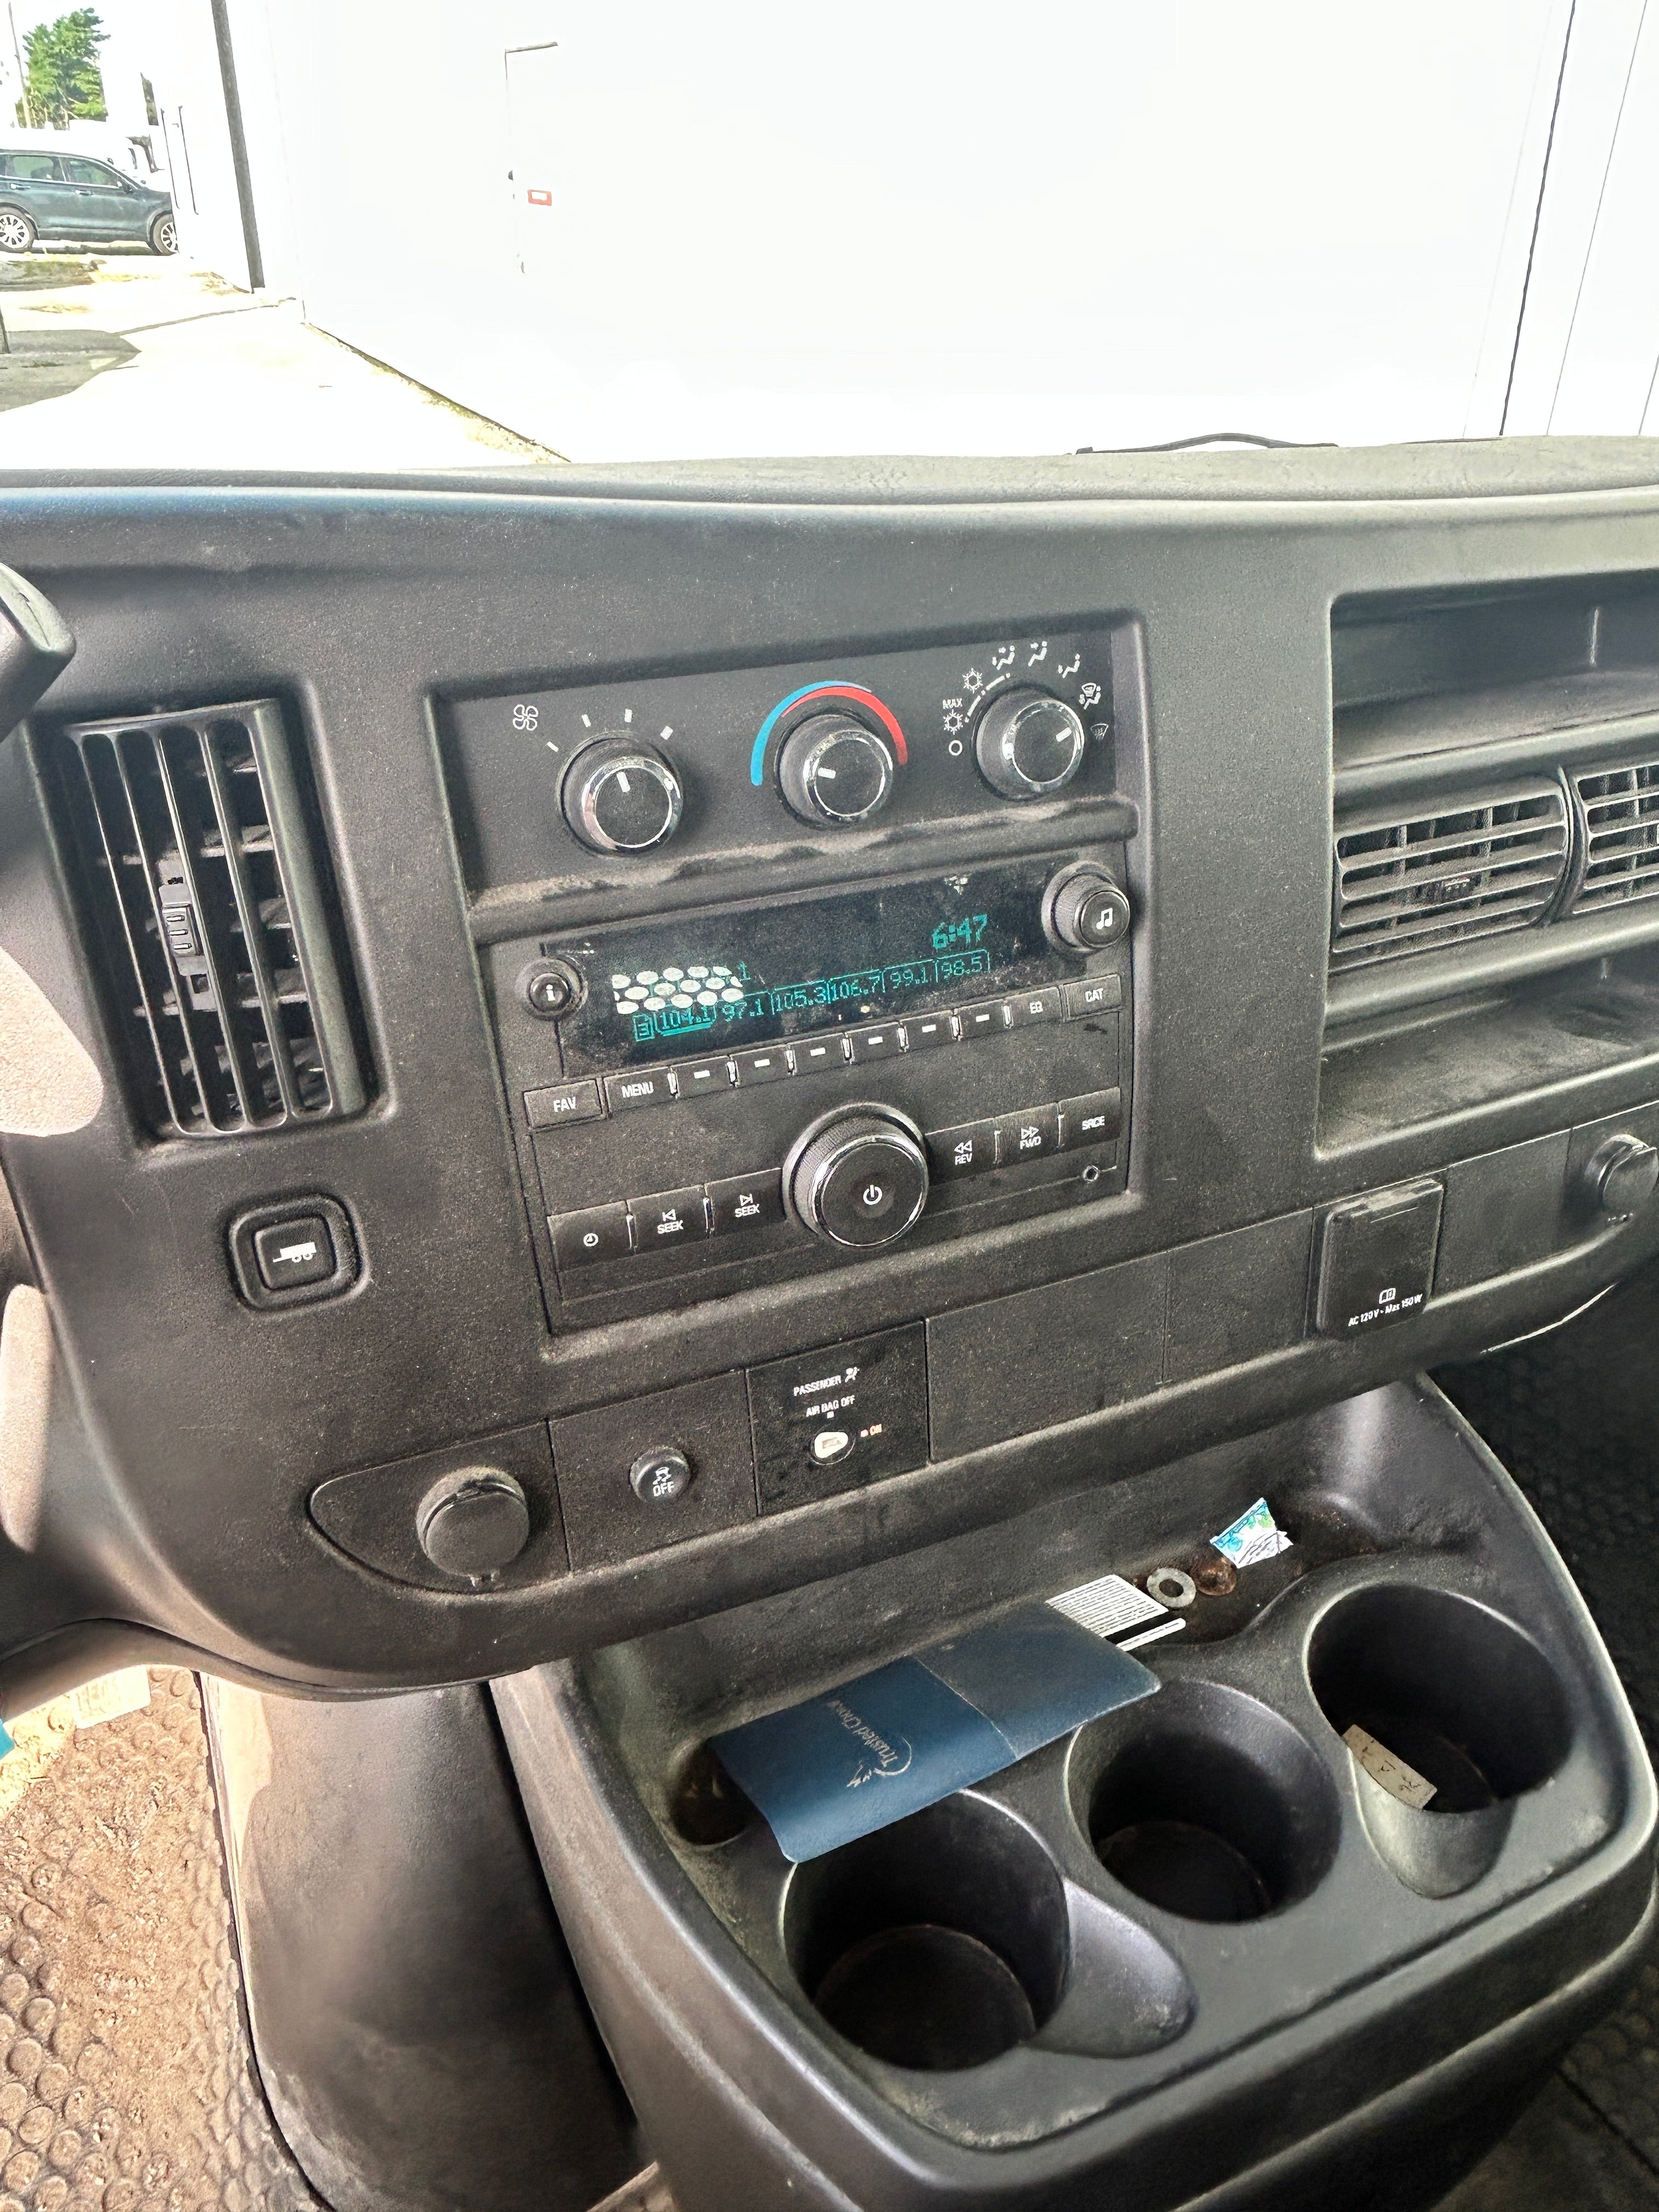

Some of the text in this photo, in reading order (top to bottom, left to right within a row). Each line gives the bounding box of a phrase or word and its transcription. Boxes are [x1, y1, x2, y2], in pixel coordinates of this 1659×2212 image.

[942, 698, 963, 709] MAX
[932, 915, 987, 949] 6:47
[660, 1005, 712, 1030] 104.1
[721, 997, 764, 1022] 97.1
[774, 985, 826, 1012] 105.3
[830, 975, 881, 1001] 106.7
[890, 967, 929, 989] 99.1
[941, 957, 983, 979] 98.5
[1085, 988, 1104, 1003] CAT
[1029, 1001, 1043, 1014] EQ
[621, 1081, 654, 1098] MENU
[553, 1096, 577, 1113] FAV
[1081, 1115, 1105, 1131] SRCE
[1020, 1136, 1041, 1150] FWD
[955, 1153, 973, 1166] REV
[734, 1203, 760, 1218] SEEK
[657, 1220, 684, 1234] SEEK
[1347, 1316, 1359, 1327] AC
[1360, 1308, 1380, 1323] 120V
[1401, 1293, 1423, 1308] 150W
[793, 1375, 842, 1397] PASSENGER
[805, 1395, 855, 1418] AIR BAG OFF
[652, 1481, 675, 1497] OFF
